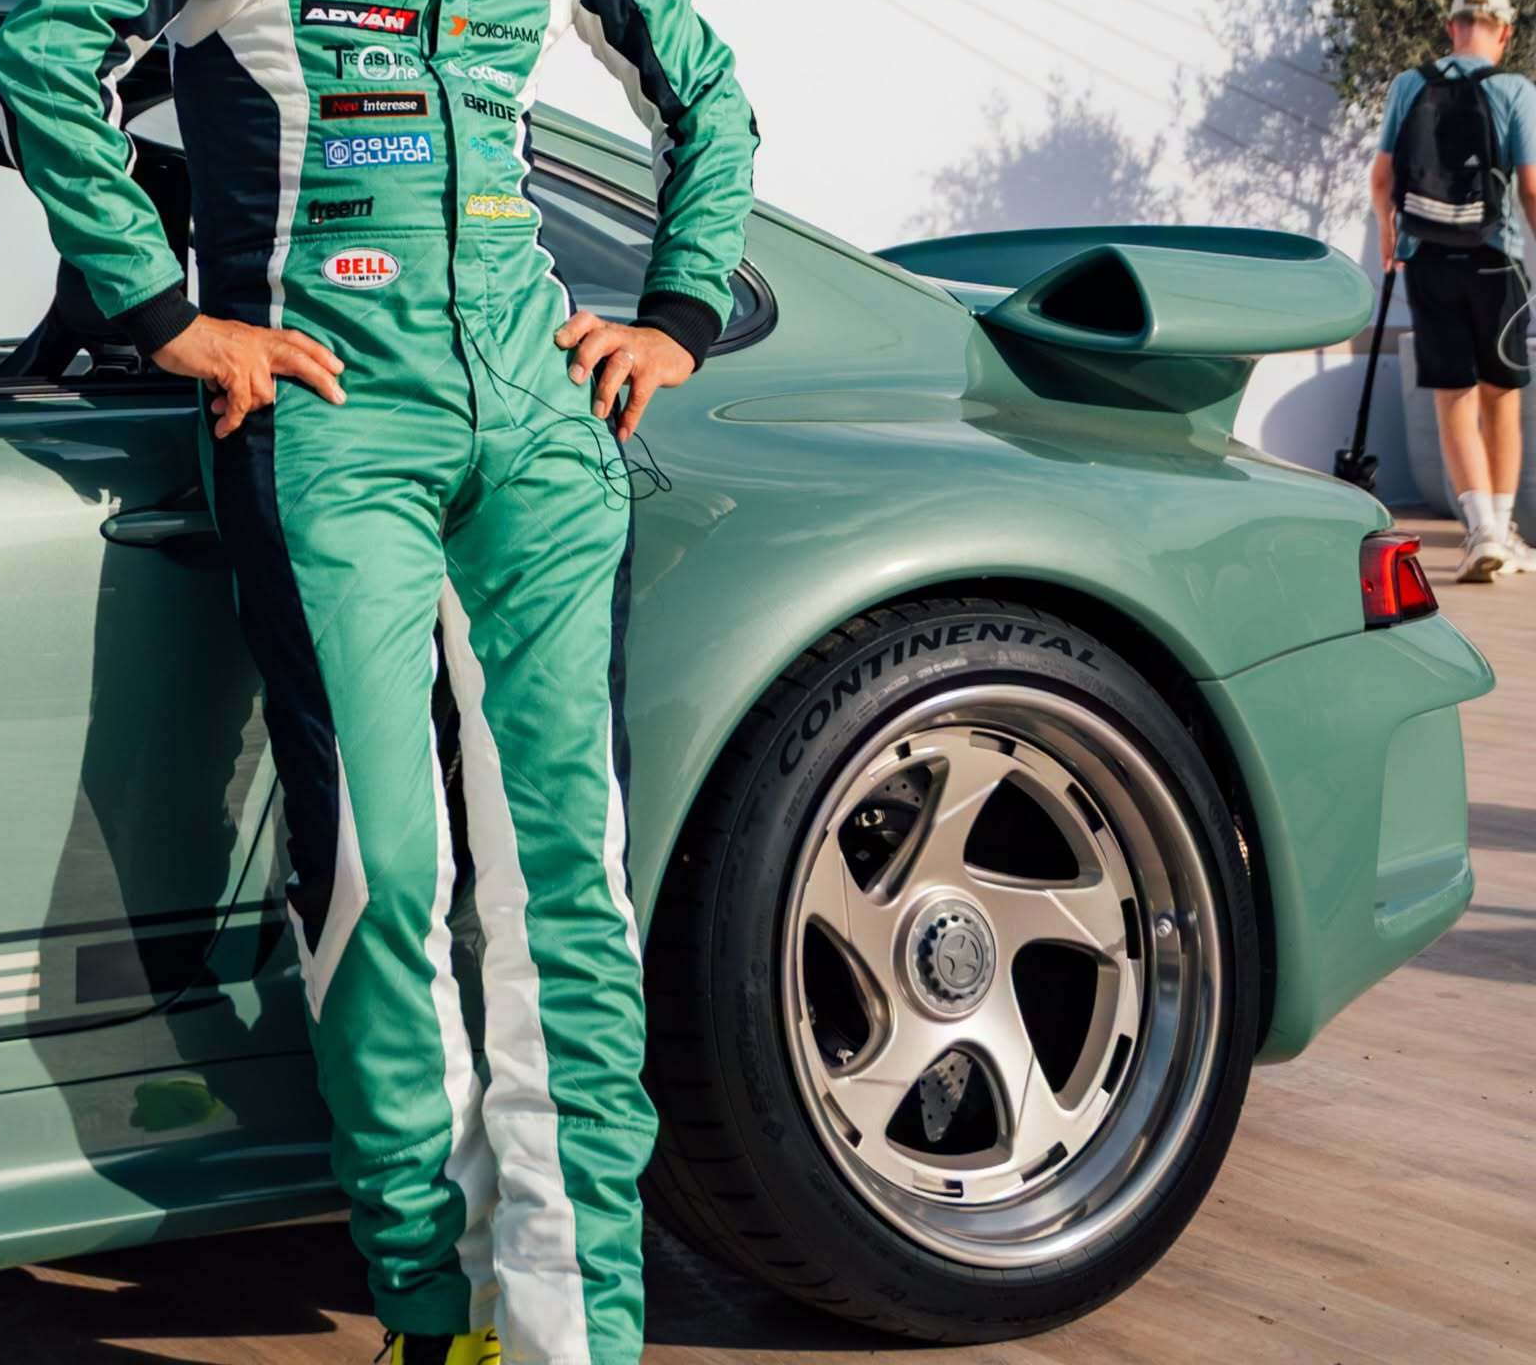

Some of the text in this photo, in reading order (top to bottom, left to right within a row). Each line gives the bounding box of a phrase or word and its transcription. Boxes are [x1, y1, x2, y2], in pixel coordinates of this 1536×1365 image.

[304, 7, 406, 31] ADVAN
[468, 20, 541, 45] YOKOHAMA
[363, 99, 418, 112] interesse
[462, 92, 517, 124] BRIDE
[352, 136, 429, 151] OGURA
[336, 257, 391, 275] BELL
[779, 623, 1102, 777] CONTINENTAL
